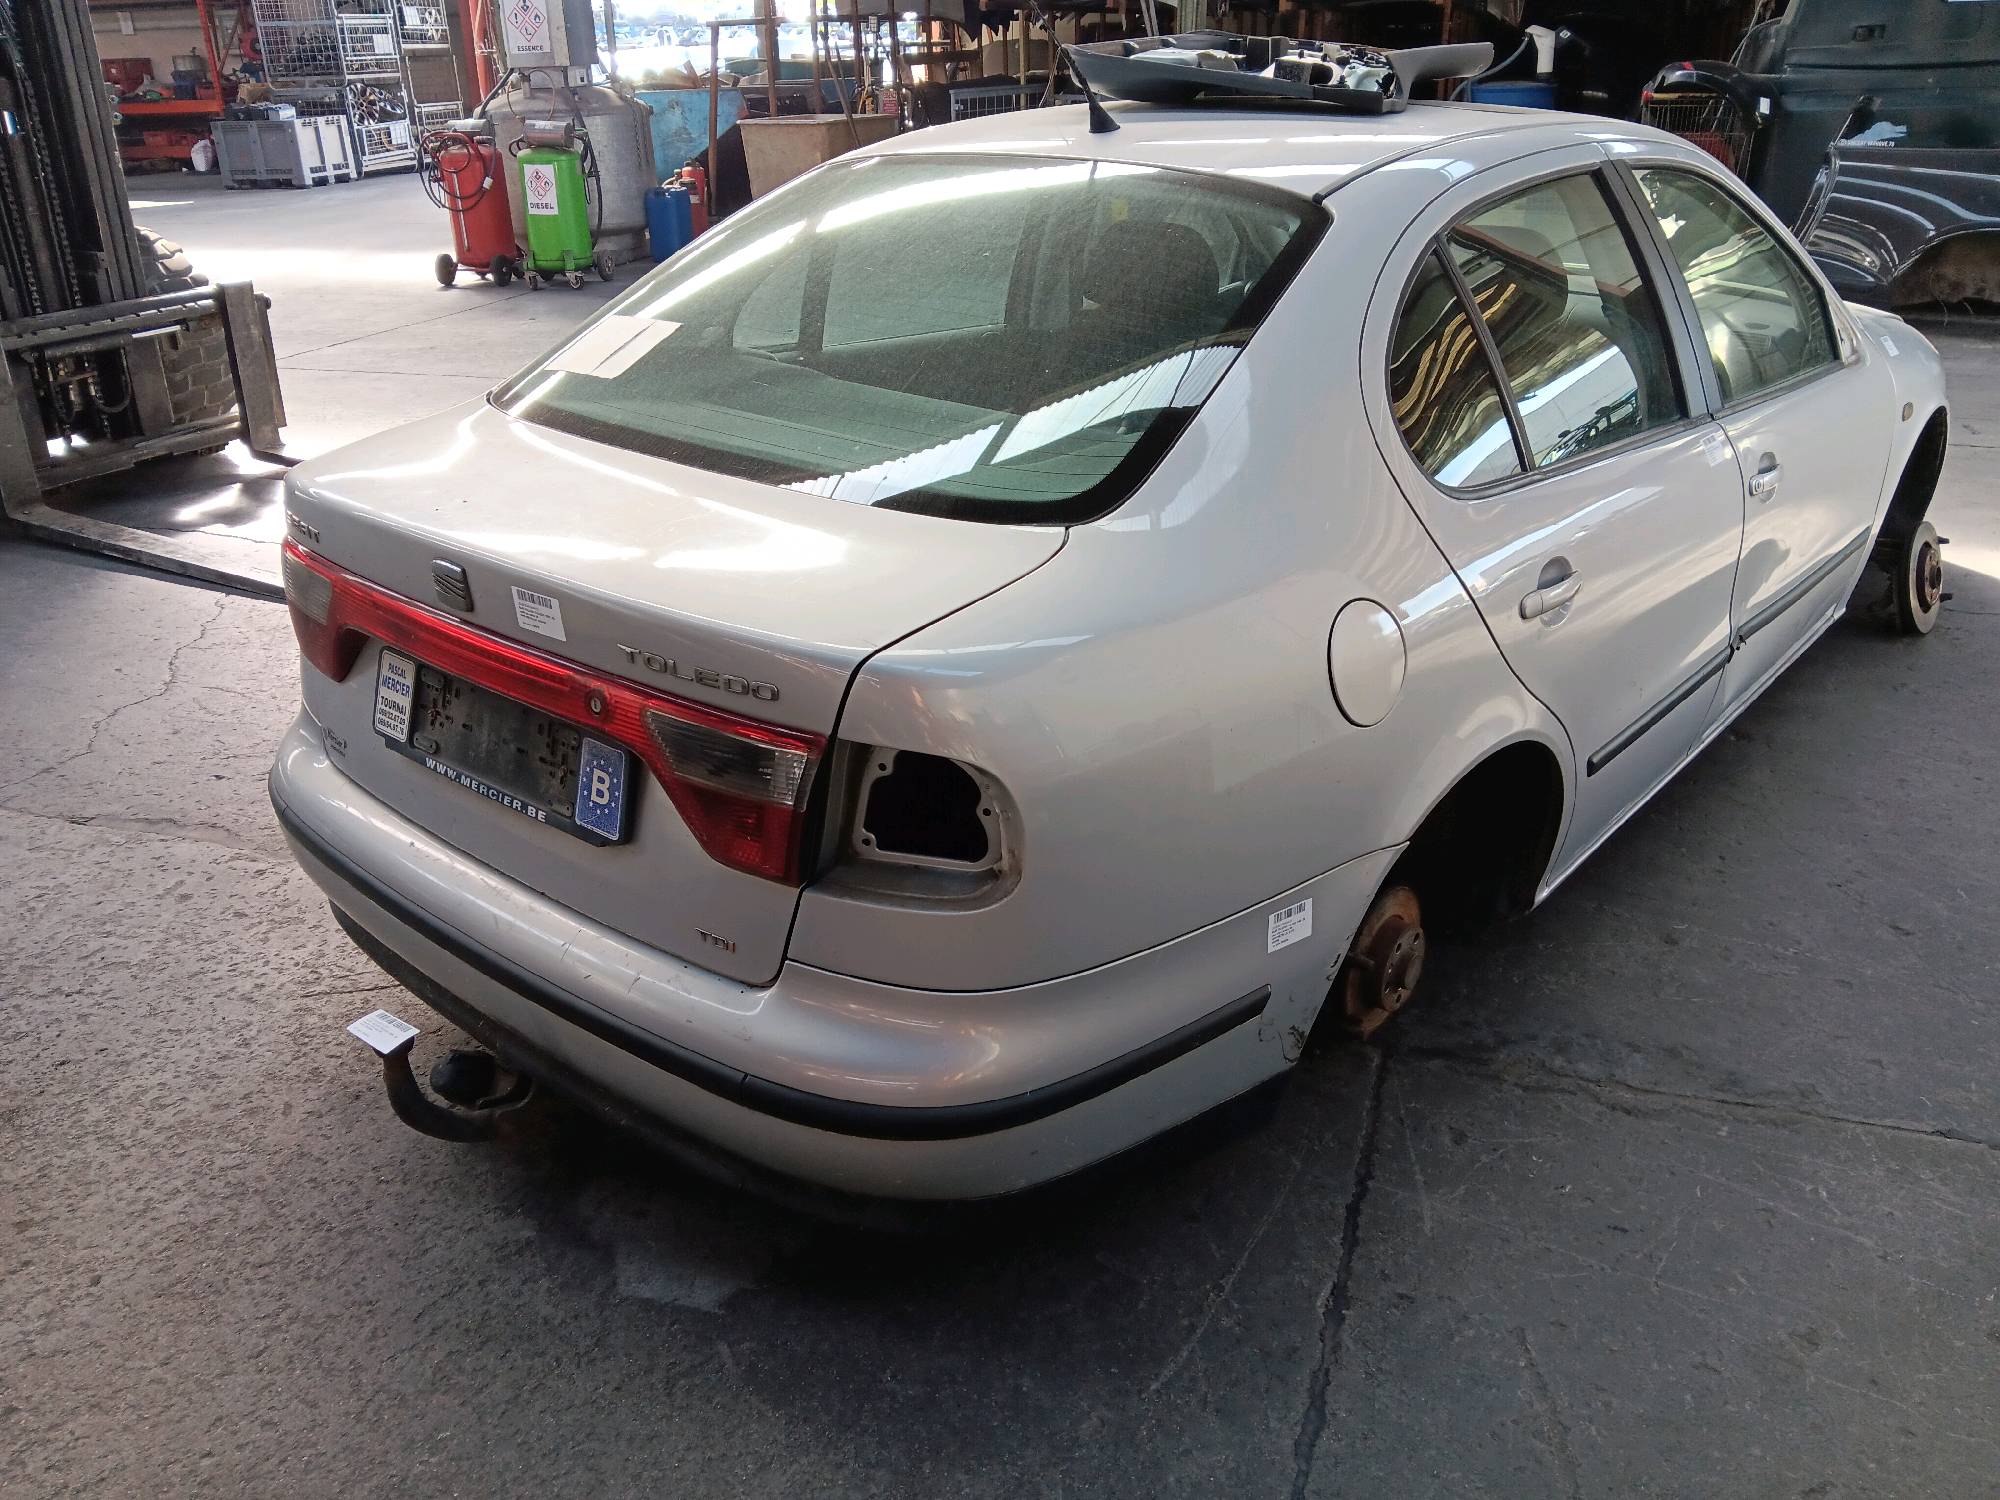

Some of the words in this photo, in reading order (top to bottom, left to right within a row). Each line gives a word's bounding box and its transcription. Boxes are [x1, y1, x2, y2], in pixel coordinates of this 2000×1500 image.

[529, 202, 555, 210] DIESEL
[387, 662, 407, 680] PASCAL
[616, 643, 780, 702] TOLEDO
[381, 674, 411, 698] MERCIER
[380, 695, 408, 717] TOURNAI
[425, 757, 547, 823] WWW.MERCIER.BE
[591, 767, 610, 805] B
[694, 927, 736, 954] TDI
